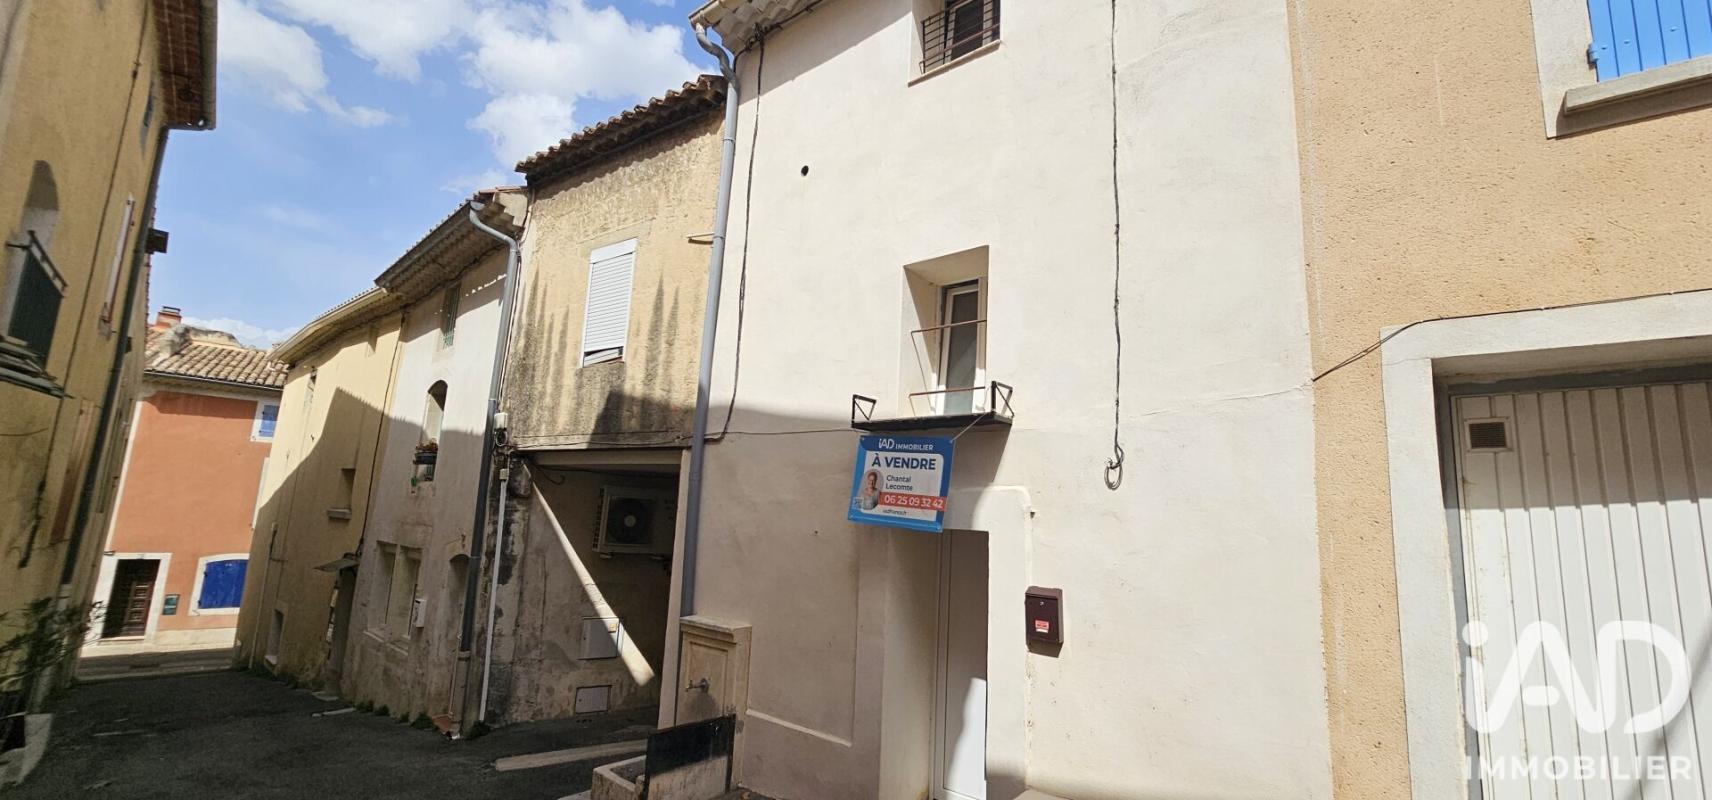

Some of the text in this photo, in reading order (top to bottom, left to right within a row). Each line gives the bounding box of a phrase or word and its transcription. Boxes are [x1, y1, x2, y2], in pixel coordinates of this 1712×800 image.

[895, 443, 934, 451] IMMOBILIER
[872, 453, 936, 470] À VENDRE
[886, 474, 911, 483] Chantal
[885, 484, 913, 492] Lecomte
[884, 494, 943, 509] 06 25 09 32 42
